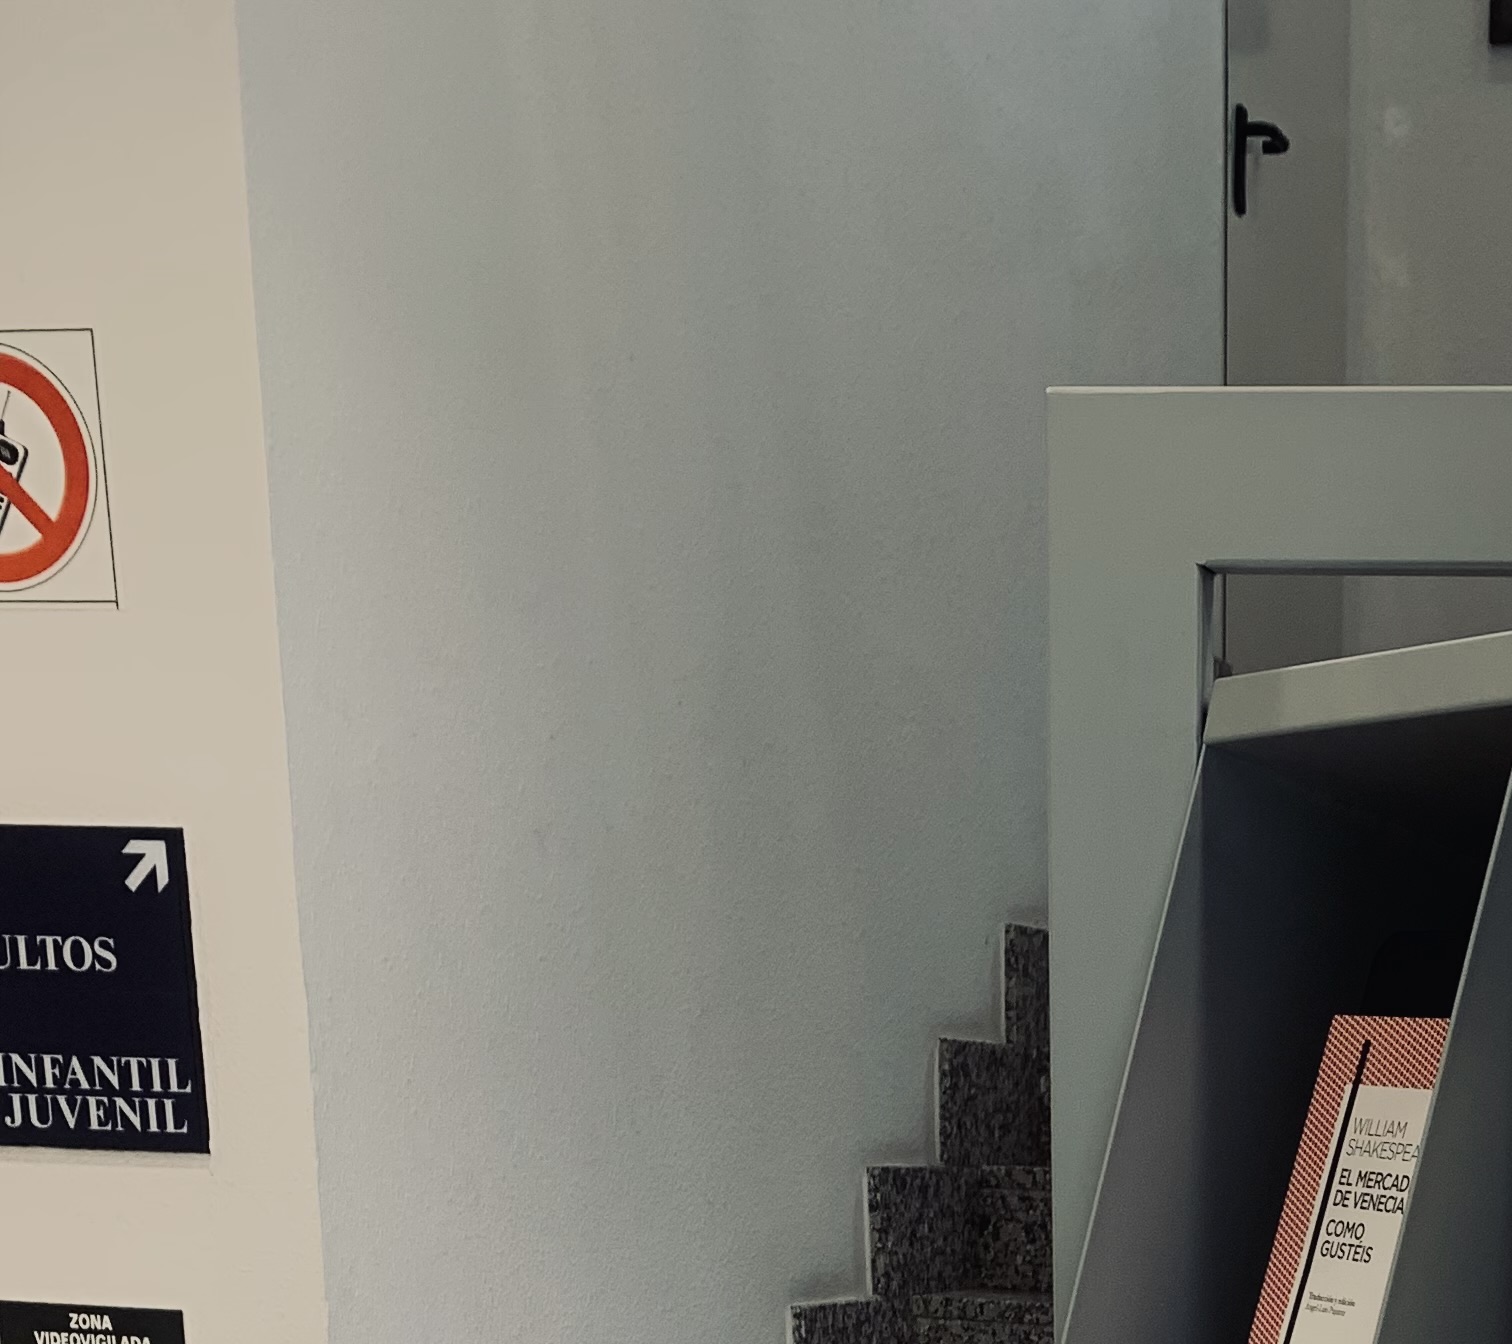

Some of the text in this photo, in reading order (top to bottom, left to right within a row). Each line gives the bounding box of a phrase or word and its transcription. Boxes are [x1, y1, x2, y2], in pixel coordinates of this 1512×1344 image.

[4, 1093, 189, 1134] JUVENIL
[1353, 1117, 1408, 1138] WILLIAM
[1339, 1168, 1353, 1186] EL
[1333, 1190, 1405, 1215] DE VENECIA
[1326, 1219, 1366, 1240] COMO
[1320, 1239, 1374, 1263] GUSTÉIS
[69, 1313, 113, 1332] ZONA
